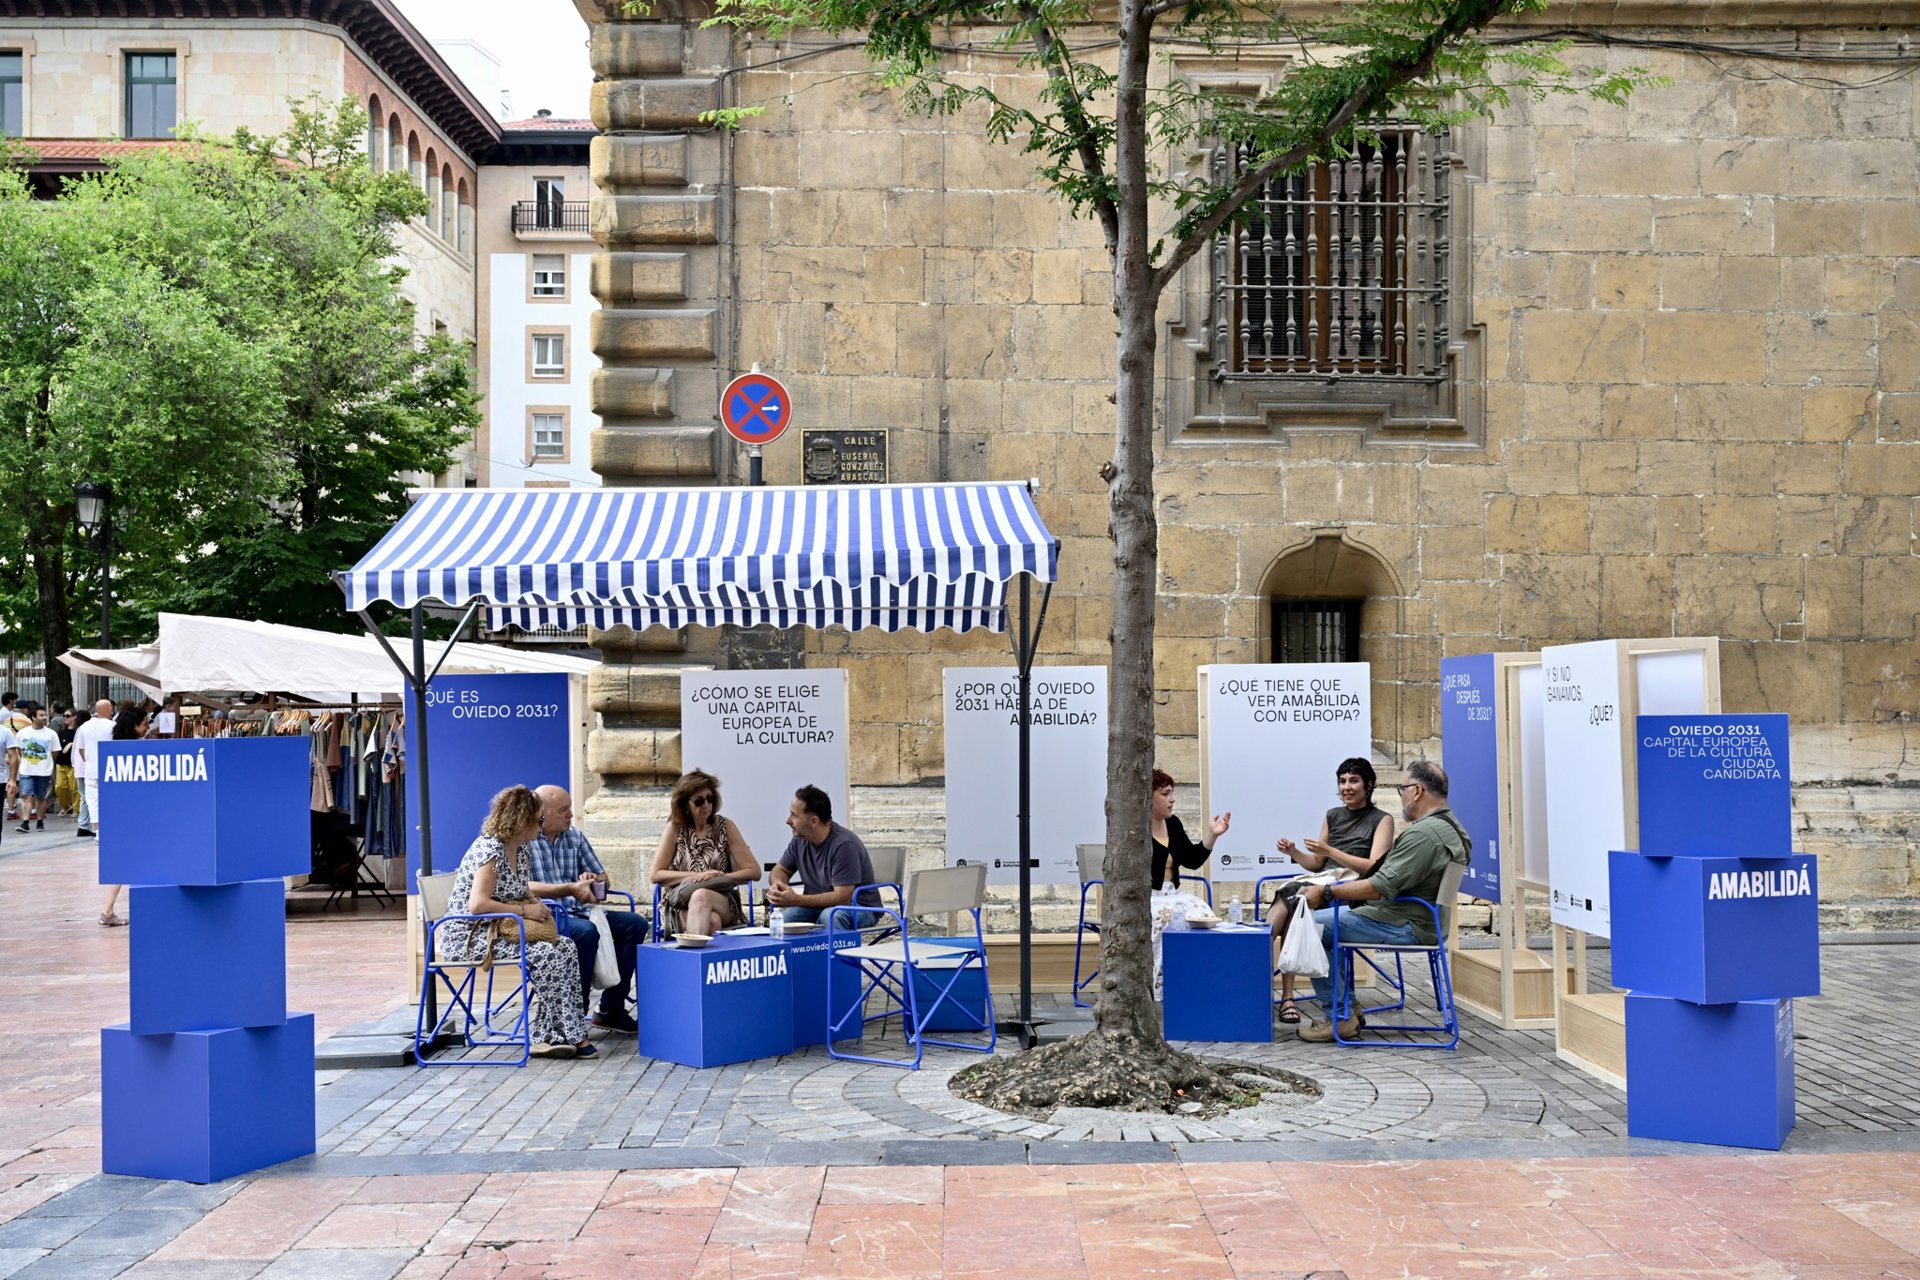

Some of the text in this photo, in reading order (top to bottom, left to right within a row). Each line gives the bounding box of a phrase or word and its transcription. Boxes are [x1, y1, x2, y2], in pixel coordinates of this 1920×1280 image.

[845, 436, 876, 446] CALLE
[841, 452, 878, 461] EUSEBIO
[840, 473, 879, 481] ABASCAL
[1457, 673, 1471, 687] PASA
[1546, 666, 1571, 682] Y SI NO
[691, 684, 820, 703] ¿CÓMO SE ELIGE
[955, 681, 1095, 699] ¿POR QU OVIEDO
[1219, 677, 1341, 695] ¿QUÉ TIENE QUE
[425, 687, 479, 707] QUÉ ES
[1247, 691, 1360, 707] VER AMABILIDÁ
[1456, 687, 1481, 704] DESPUÉS
[452, 704, 559, 719] OVIEDO 2031?
[708, 701, 805, 715] UNA CAPITAL
[955, 697, 1068, 711] 2031 HABA DE
[1010, 710, 1097, 726] AABILIDÁ?
[1254, 708, 1361, 723] CON EUROPA?
[1467, 706, 1492, 721] DE 2031?
[1589, 700, 1614, 726] ¿QUÉ?
[722, 715, 817, 730] EUROPEA DE
[736, 730, 834, 745] LA CULTURA?
[1669, 725, 1762, 736] OVIEDO 2031
[1643, 736, 1768, 748] CAPITAL EUROPEA
[1668, 747, 1773, 758] DE LA CULTURA
[103, 747, 208, 783] AMABILIDÁ
[1722, 758, 1776, 769] CIUDAD
[1703, 768, 1782, 780] CANDIDATA
[1708, 863, 1811, 901] AMABILIDÁ
[790, 940, 856, 954] ww.oviedo031.eu
[705, 949, 788, 985] AMABILIDÁ
